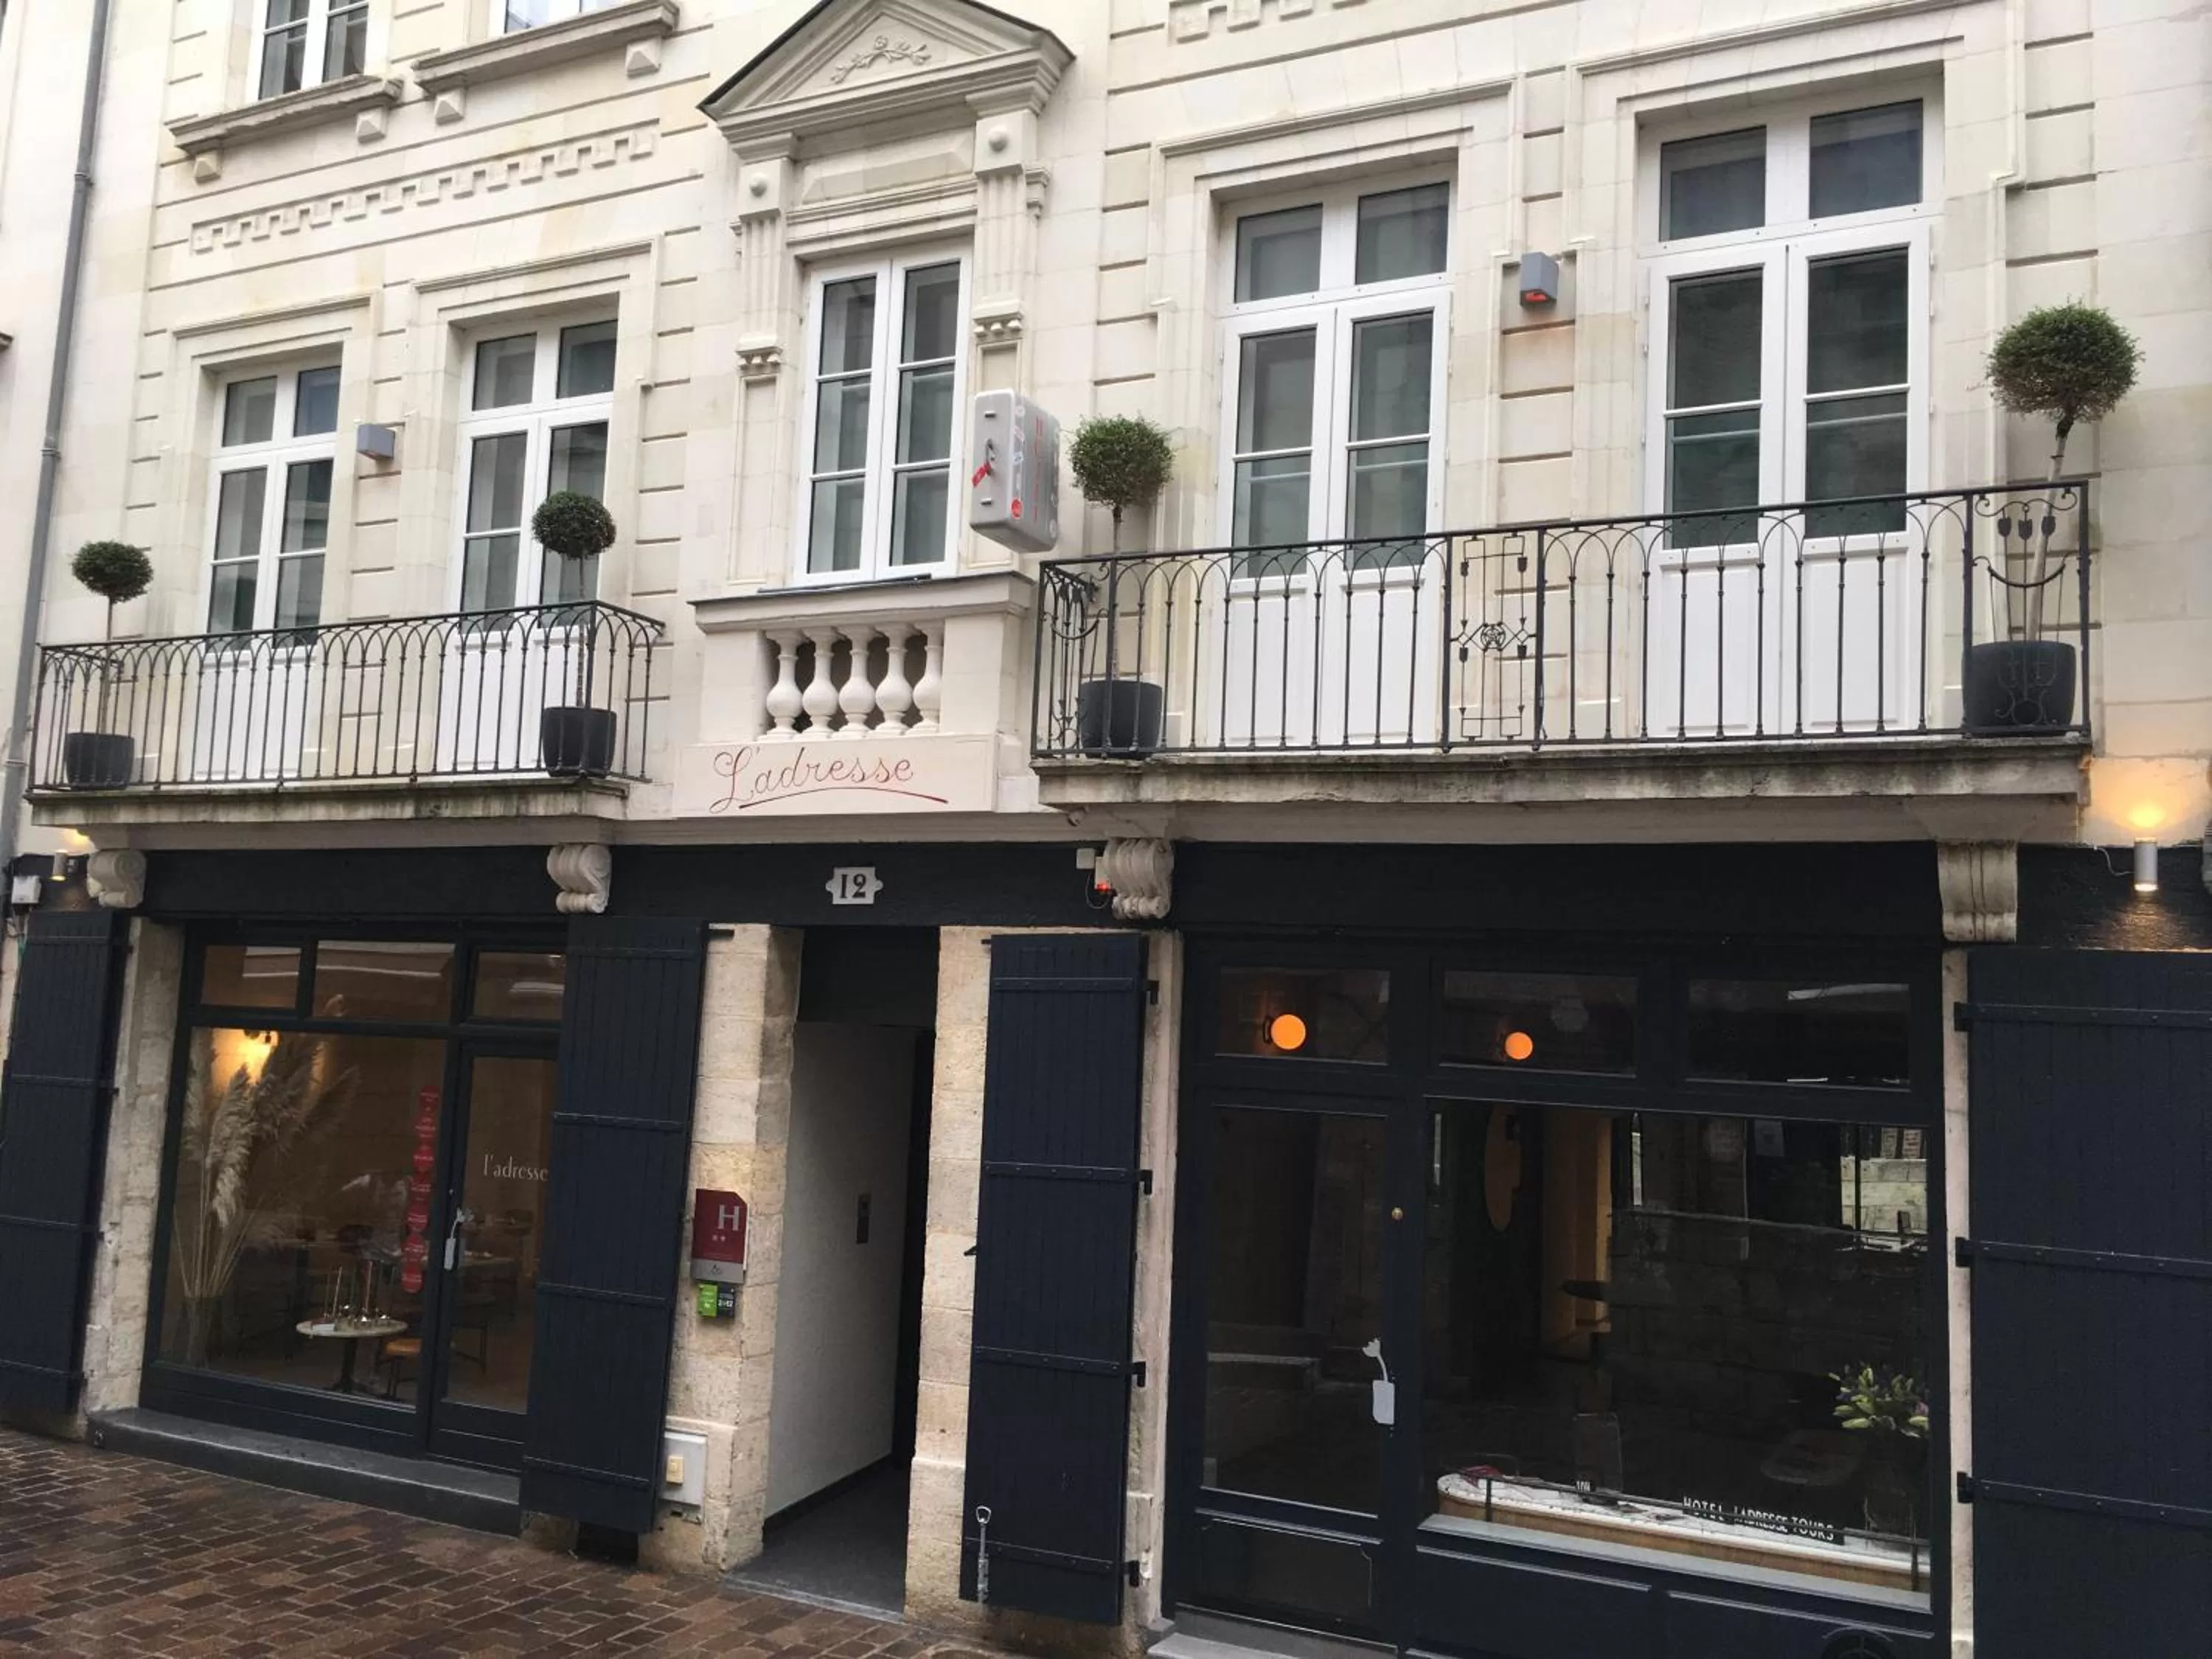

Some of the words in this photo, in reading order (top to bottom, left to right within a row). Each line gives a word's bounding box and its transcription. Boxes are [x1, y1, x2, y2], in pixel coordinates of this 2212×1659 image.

[709, 745, 913, 814] L'adresse
[840, 873, 866, 898] 12
[484, 1154, 549, 1181] l'adresse
[717, 1204, 740, 1231] H
